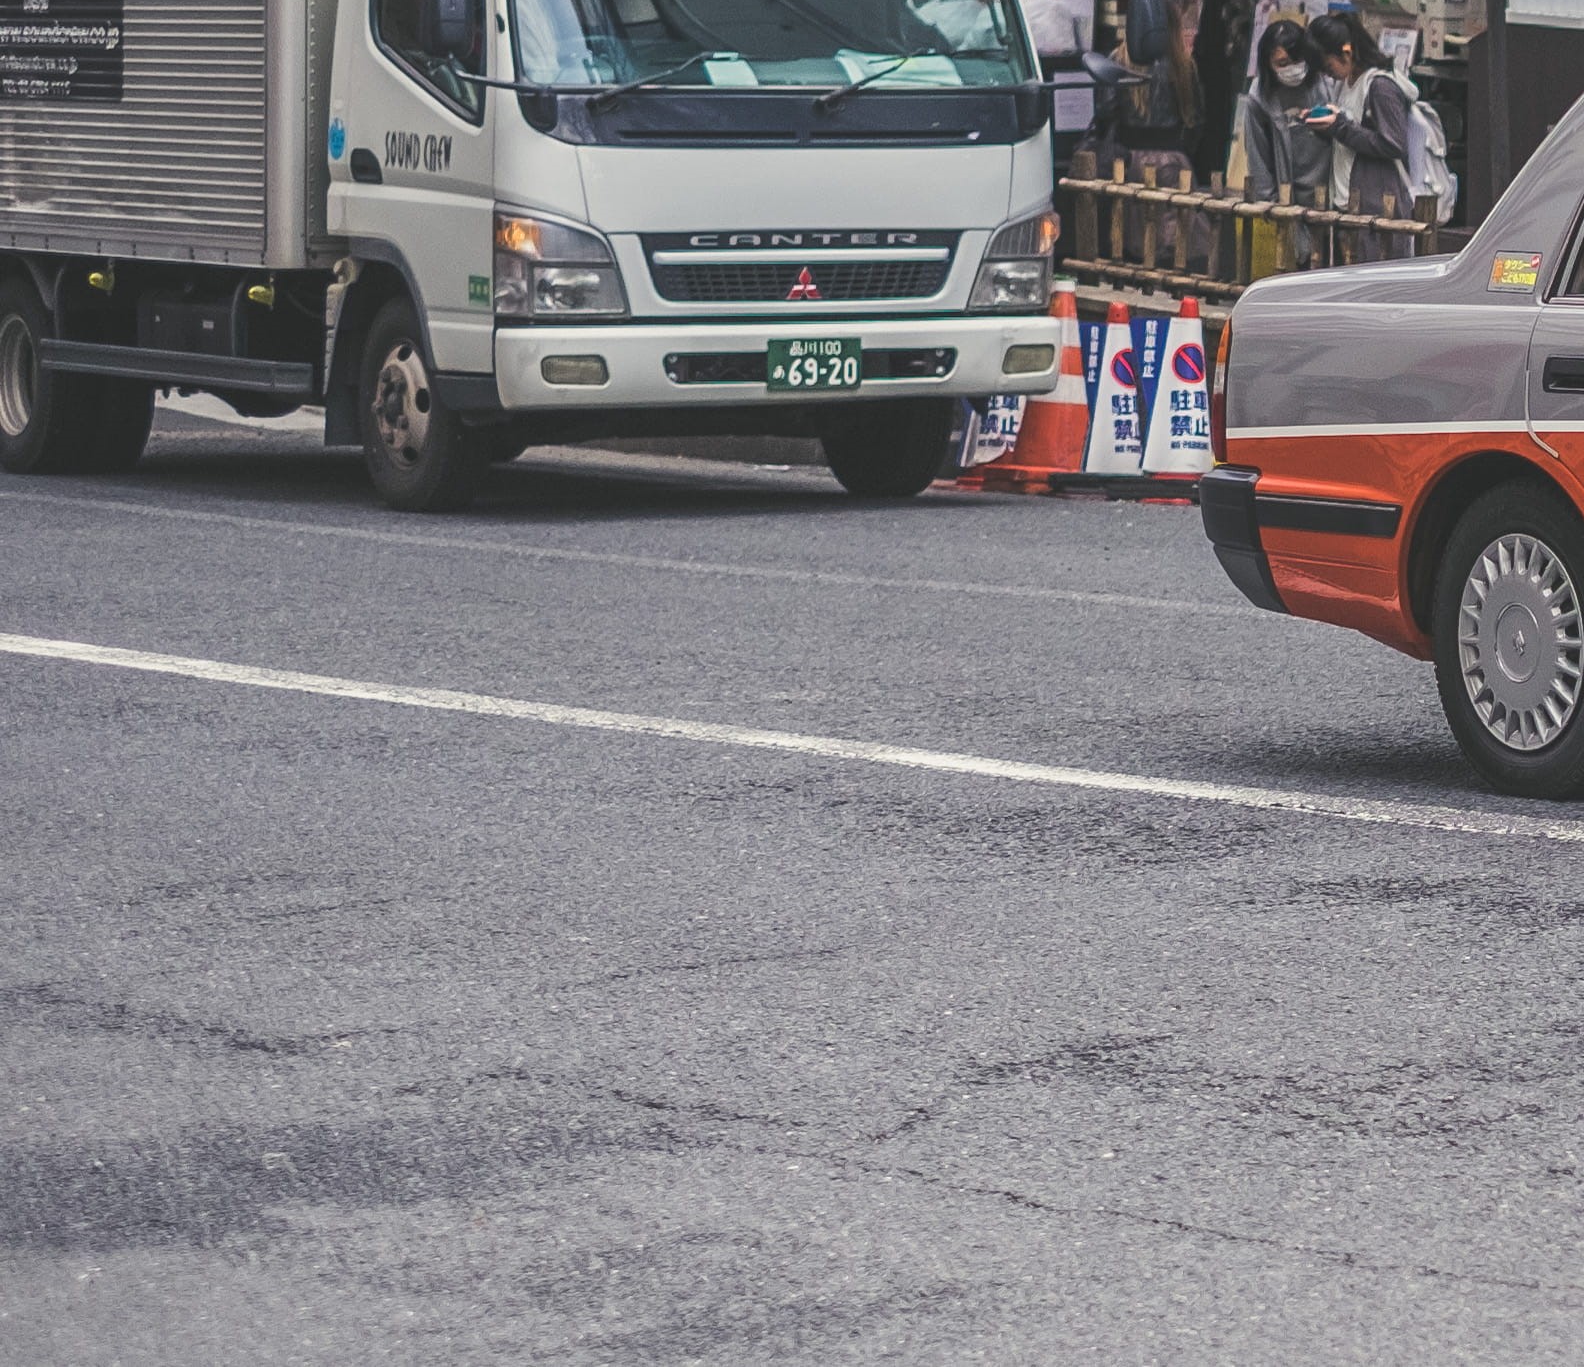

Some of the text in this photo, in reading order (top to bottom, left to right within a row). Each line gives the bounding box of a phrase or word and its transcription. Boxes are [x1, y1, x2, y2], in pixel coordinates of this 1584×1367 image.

[384, 131, 454, 172] SOUND CREW
[689, 233, 918, 248] CANTER
[787, 356, 859, 387] 69-20
[1170, 390, 1209, 412] 駐車
[1170, 416, 1210, 437] 禁止
